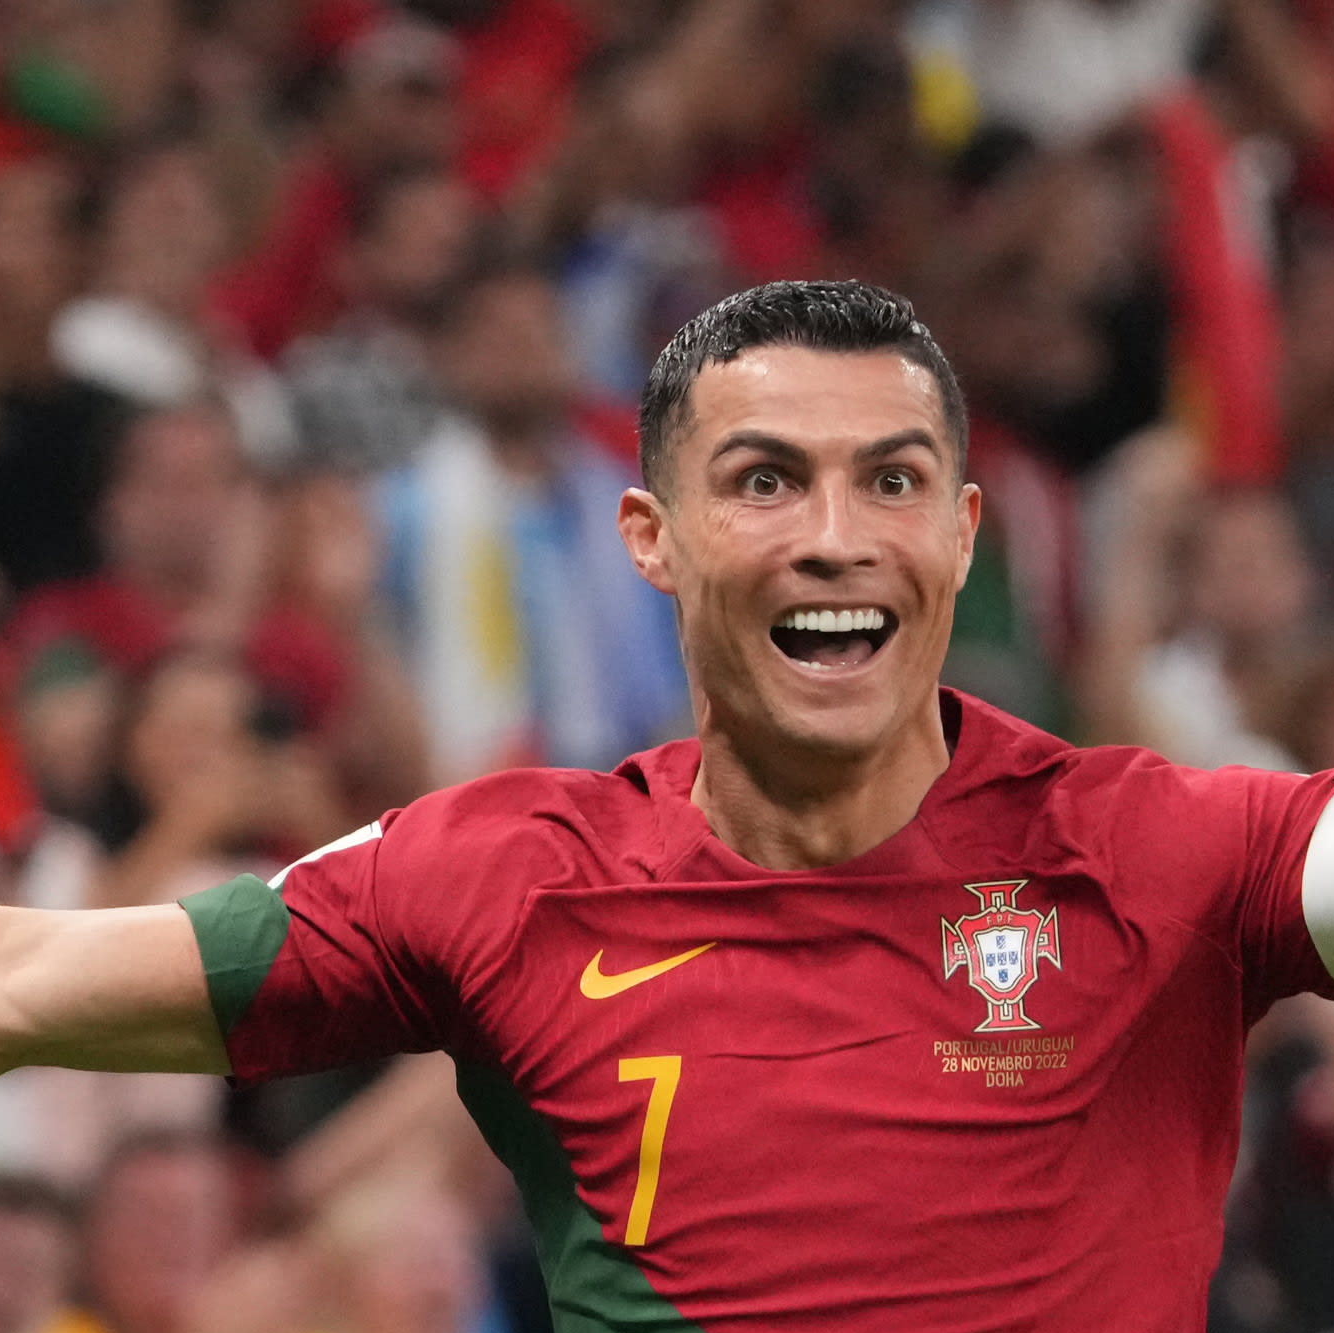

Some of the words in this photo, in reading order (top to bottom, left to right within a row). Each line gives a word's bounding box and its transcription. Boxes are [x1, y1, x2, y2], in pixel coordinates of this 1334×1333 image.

[933, 1036, 1075, 1056] PORTUGAL/URUGUAI
[941, 1057, 959, 1073] 28
[961, 1055, 1033, 1073] NOVEMBRO
[1035, 1052, 1068, 1071] 2022
[986, 1071, 1025, 1088] DOHA
[618, 1055, 682, 1246] 7
